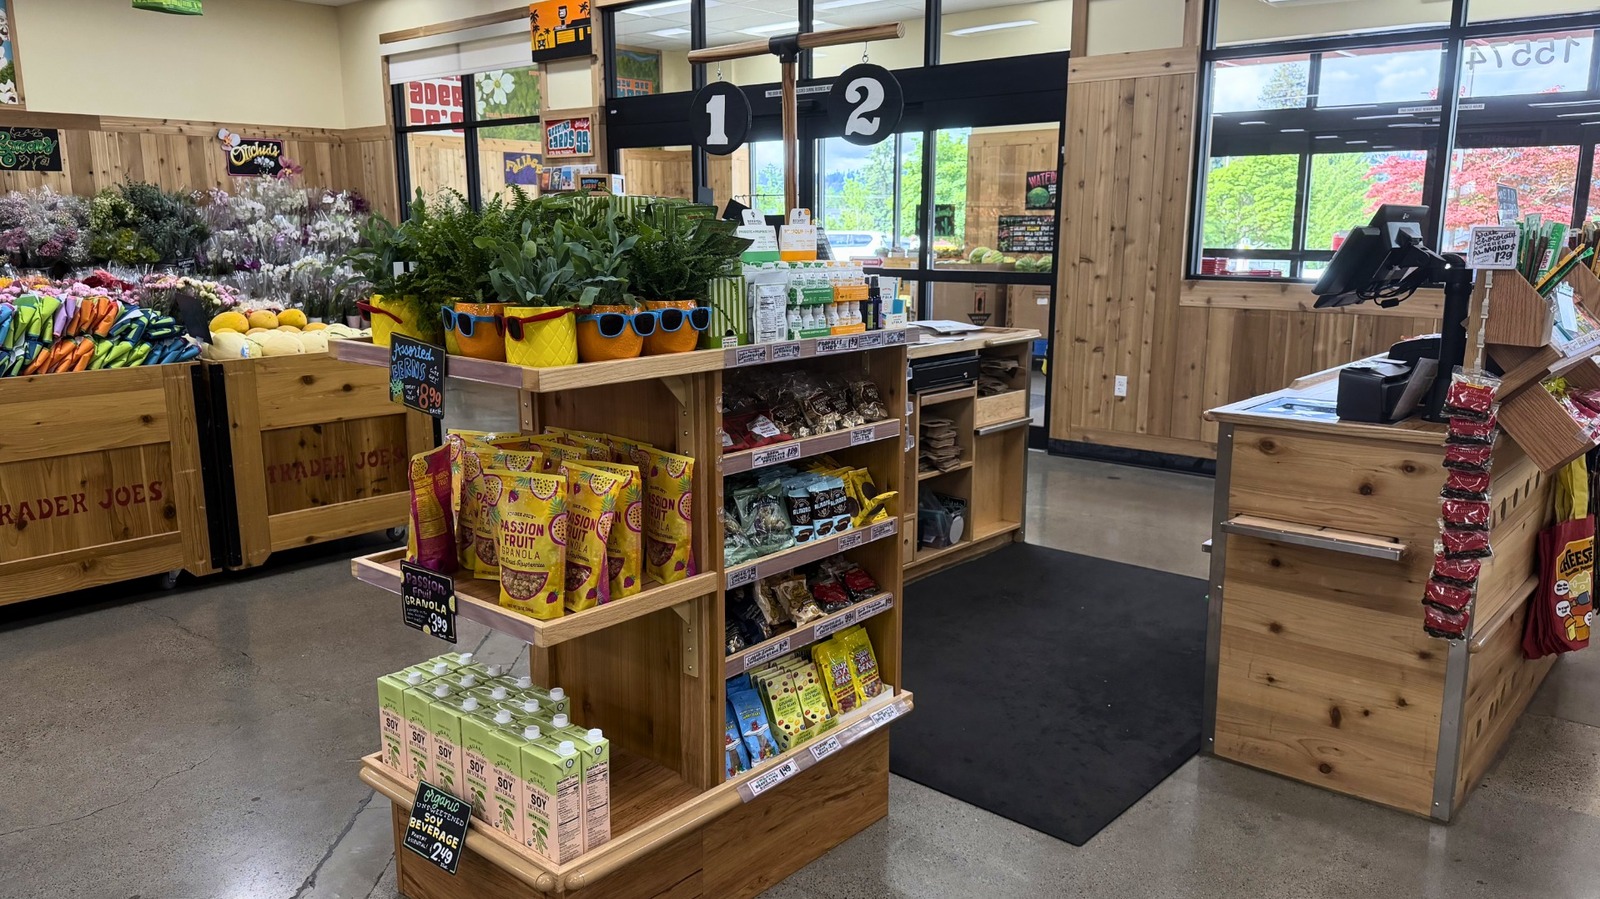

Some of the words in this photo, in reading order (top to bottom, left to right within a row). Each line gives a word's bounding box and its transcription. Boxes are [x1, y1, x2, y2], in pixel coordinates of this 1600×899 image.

[845, 76, 885, 136] 2
[705, 94, 729, 145] 1
[549, 130, 575, 148] CARDS
[230, 142, 280, 166] Orchids
[1473, 243, 1516, 257] ALMONDS
[1494, 251, 1513, 263] 1.29
[392, 343, 435, 361] Assorted
[267, 454, 347, 484] TRADER
[355, 448, 405, 470] JOES
[98, 481, 163, 510] JOES
[830, 496, 847, 506] ALMOND
[792, 506, 811, 516] ALMOND
[814, 499, 831, 510] ALMOND
[504, 534, 536, 549] FRUIT
[502, 546, 541, 560] GRANOLA
[406, 572, 447, 595] Passion
[412, 586, 432, 599] Fruit
[404, 595, 447, 615] GRANOLA
[386, 717, 399, 731] SOY
[412, 731, 425, 745] SOY
[438, 745, 452, 760] SOY
[469, 759, 484, 775] SOY
[779, 765, 792, 777] 1.49
[497, 777, 513, 792] SOY
[423, 789, 460, 813] organic
[531, 794, 547, 810] SOY
[416, 801, 465, 827] UNSWEETENED
[424, 812, 443, 828] SOY
[409, 817, 459, 849] BEVERAGE
